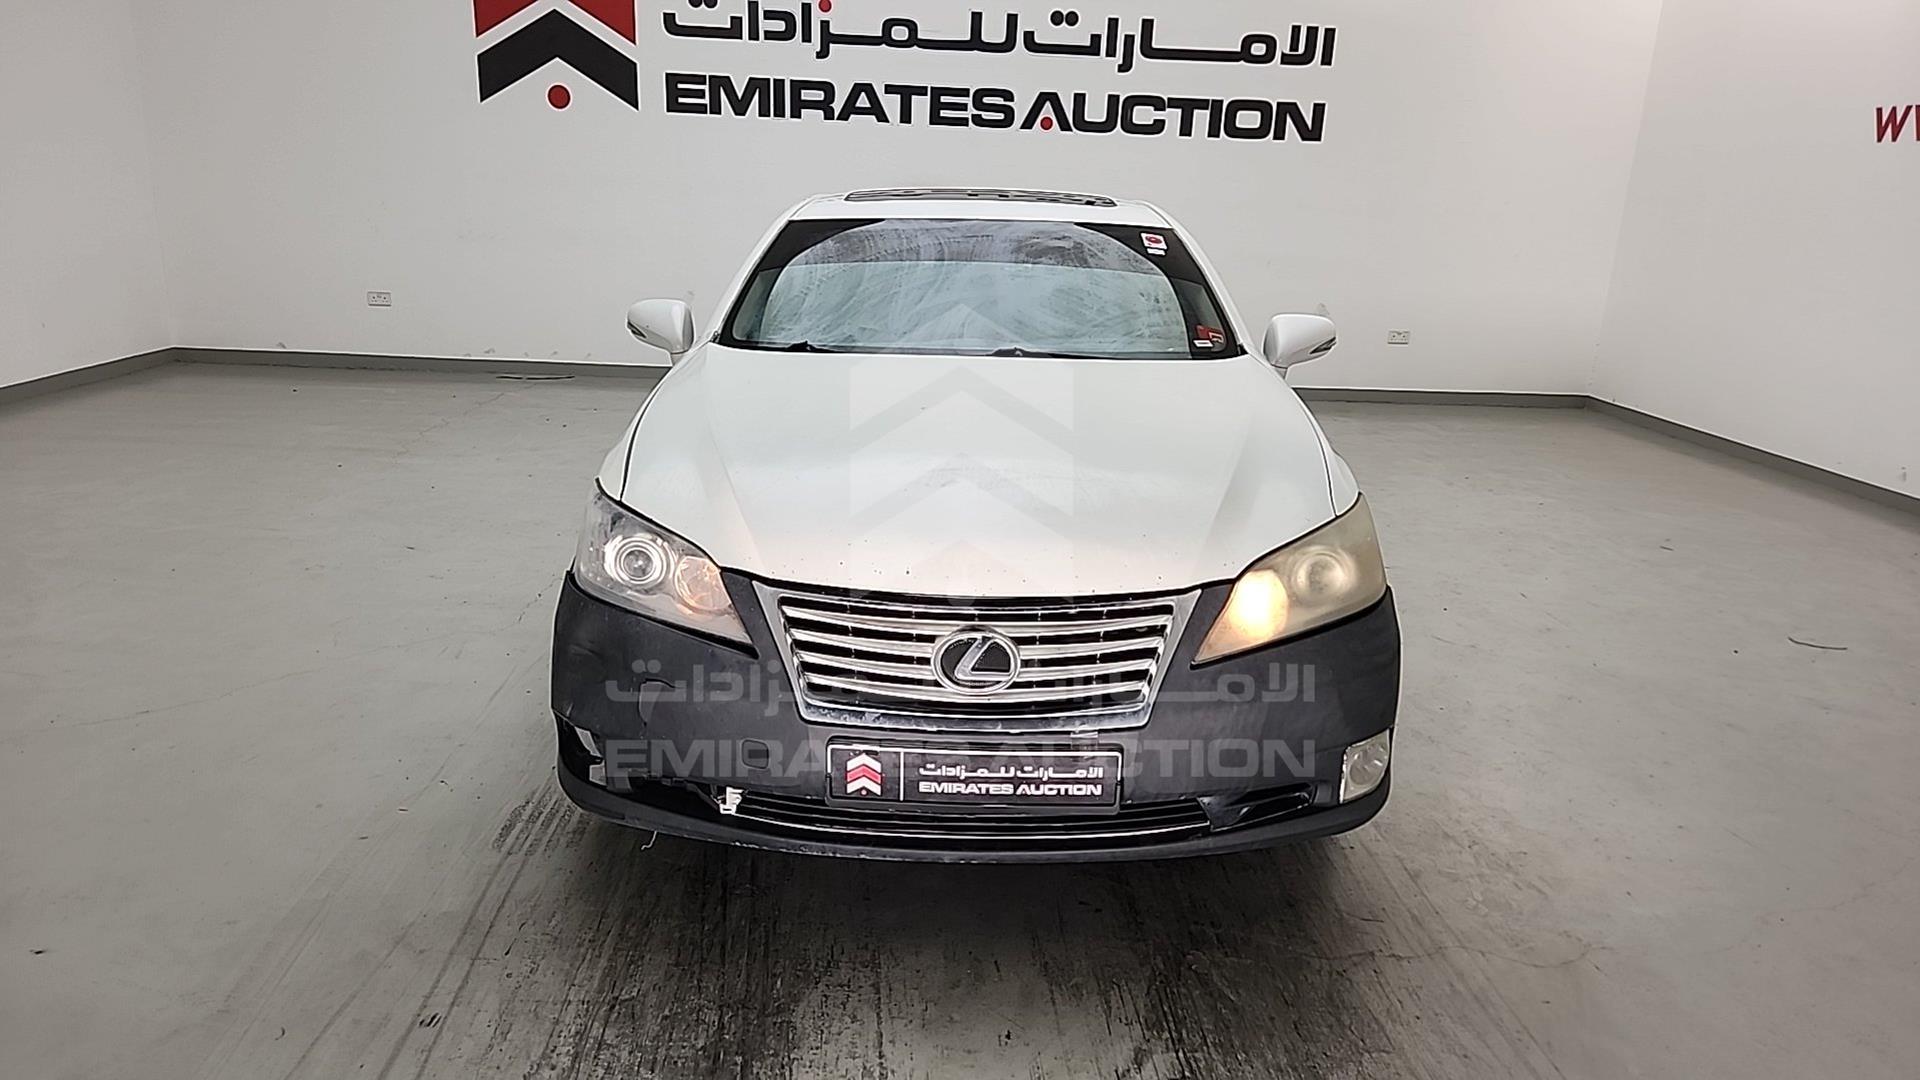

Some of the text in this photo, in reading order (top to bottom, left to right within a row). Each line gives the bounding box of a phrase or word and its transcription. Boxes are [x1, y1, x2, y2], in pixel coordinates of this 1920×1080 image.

[663, 0, 1337, 74] الامارات للمزادات
[664, 72, 1327, 142] EMIRATES AUCTION
[1875, 104, 1920, 143] W
[918, 763, 1104, 781] الامارات للمزادات
[918, 781, 1103, 796] EMIRATES AUCTION
